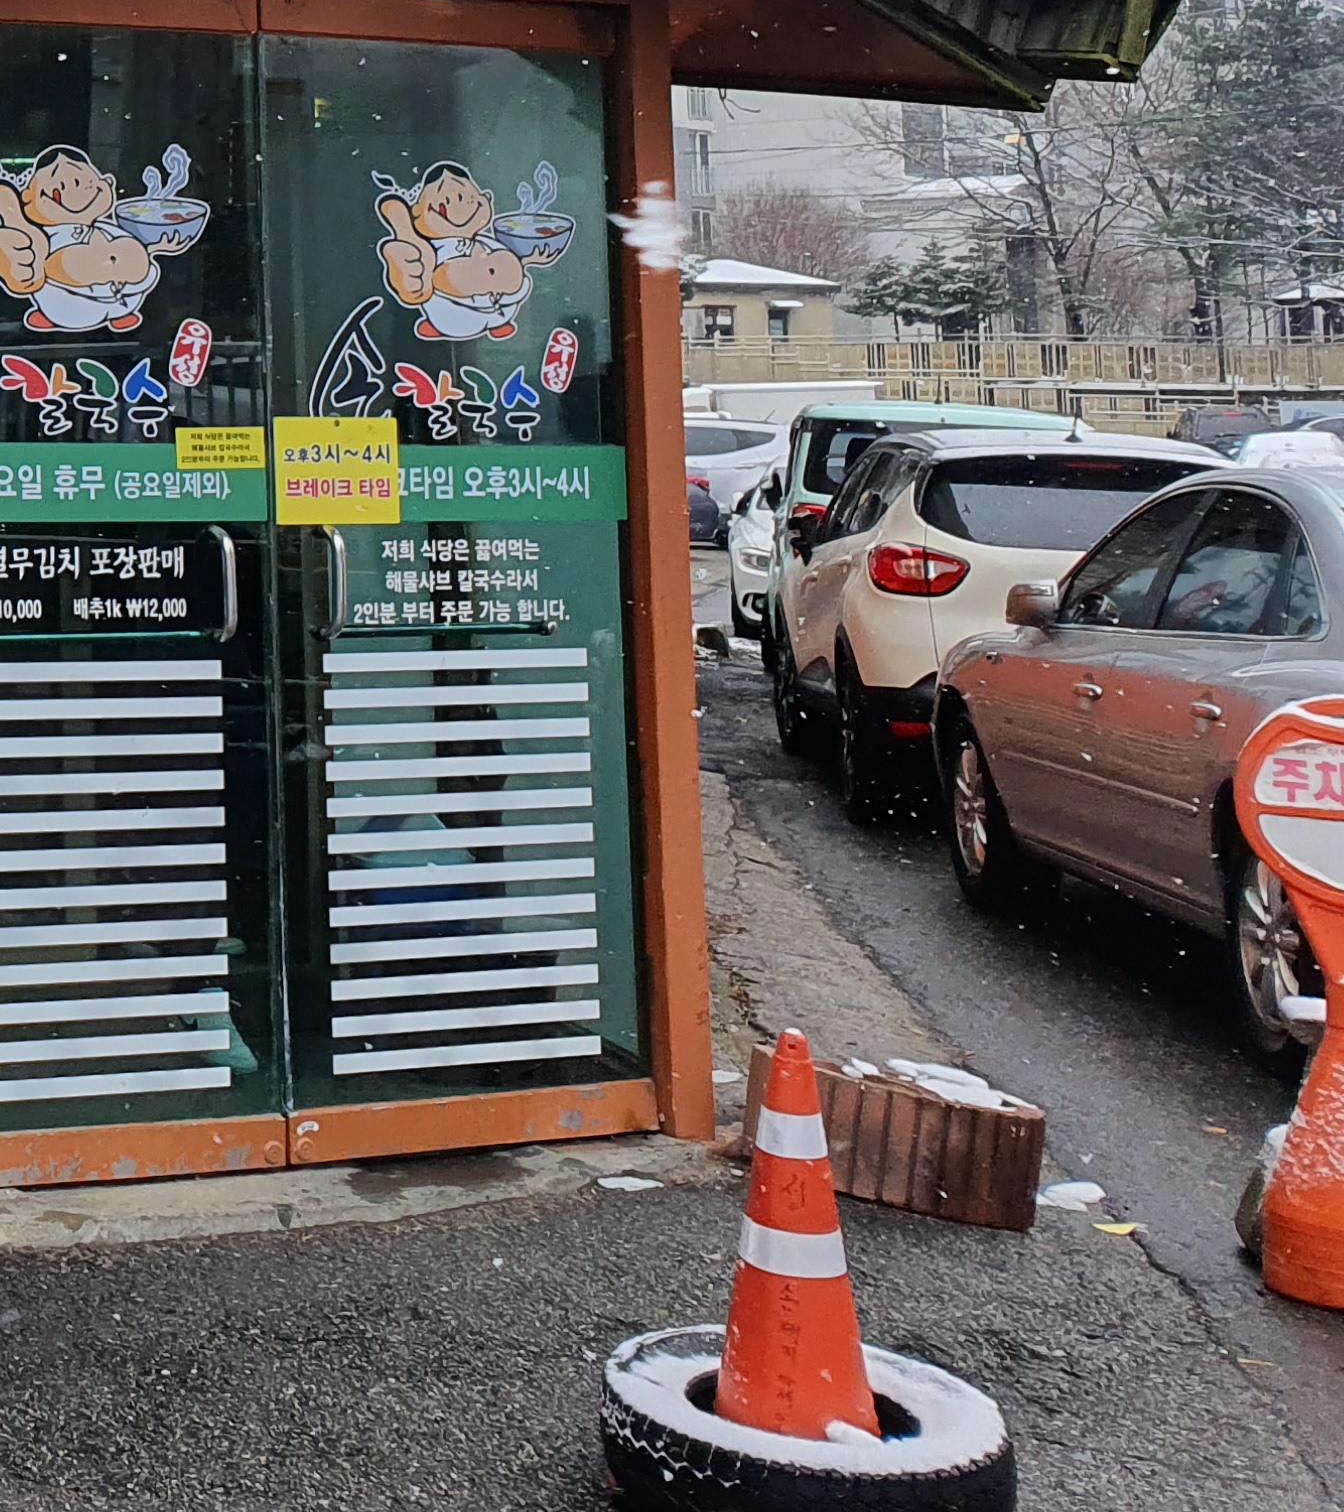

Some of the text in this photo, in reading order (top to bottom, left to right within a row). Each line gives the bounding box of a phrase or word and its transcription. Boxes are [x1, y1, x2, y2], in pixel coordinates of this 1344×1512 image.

[52, 464, 107, 500] 휴무
[285, 477, 391, 498] 브레이크 타임
[462, 466, 592, 501] 오후3시~4시
[88, 545, 185, 579] 포장판매
[381, 539, 541, 562] 저희 식당은 끓여먹는
[385, 568, 539, 592] 해물샤브 칼국수라서
[353, 599, 571, 625] 2인분 부터 주문 가능 합니다.
